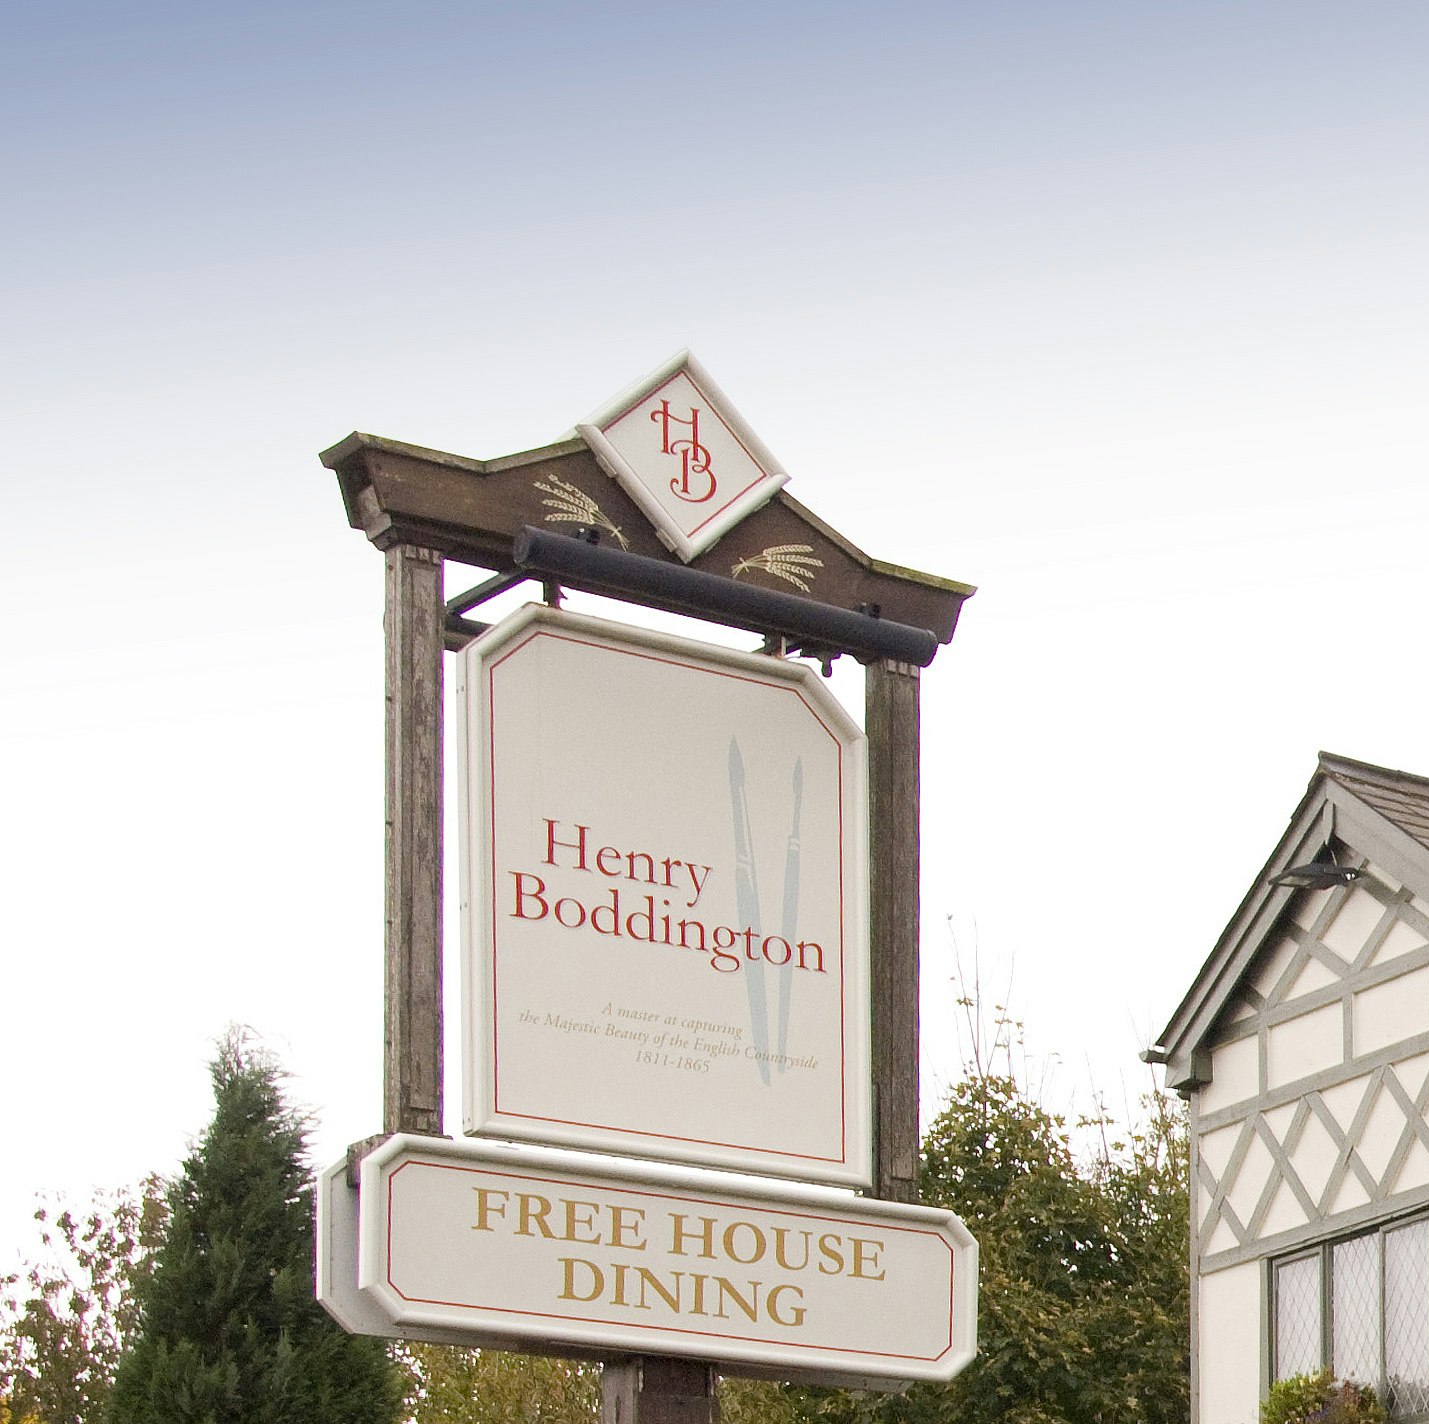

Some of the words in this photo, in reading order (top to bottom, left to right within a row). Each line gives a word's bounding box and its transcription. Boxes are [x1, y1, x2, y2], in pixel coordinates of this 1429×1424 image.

[541, 818, 714, 909] Henry
[508, 870, 828, 973] Boddington
[519, 1009, 541, 1025] the
[544, 1012, 601, 1035] Majestic
[603, 1023, 651, 1046] Beauty
[651, 1030, 669, 1048] of
[669, 1033, 690, 1050] the
[693, 1038, 741, 1060] English
[744, 1046, 820, 1071] Countryside
[601, 1002, 613, 1016] A
[617, 1007, 661, 1023] master
[663, 1015, 678, 1026] at
[681, 1017, 744, 1040] capturing
[635, 1049, 711, 1074] 1811-1865
[471, 1186, 648, 1252] FREE
[667, 1211, 887, 1282] HOUSE
[557, 1256, 808, 1328] DINING
